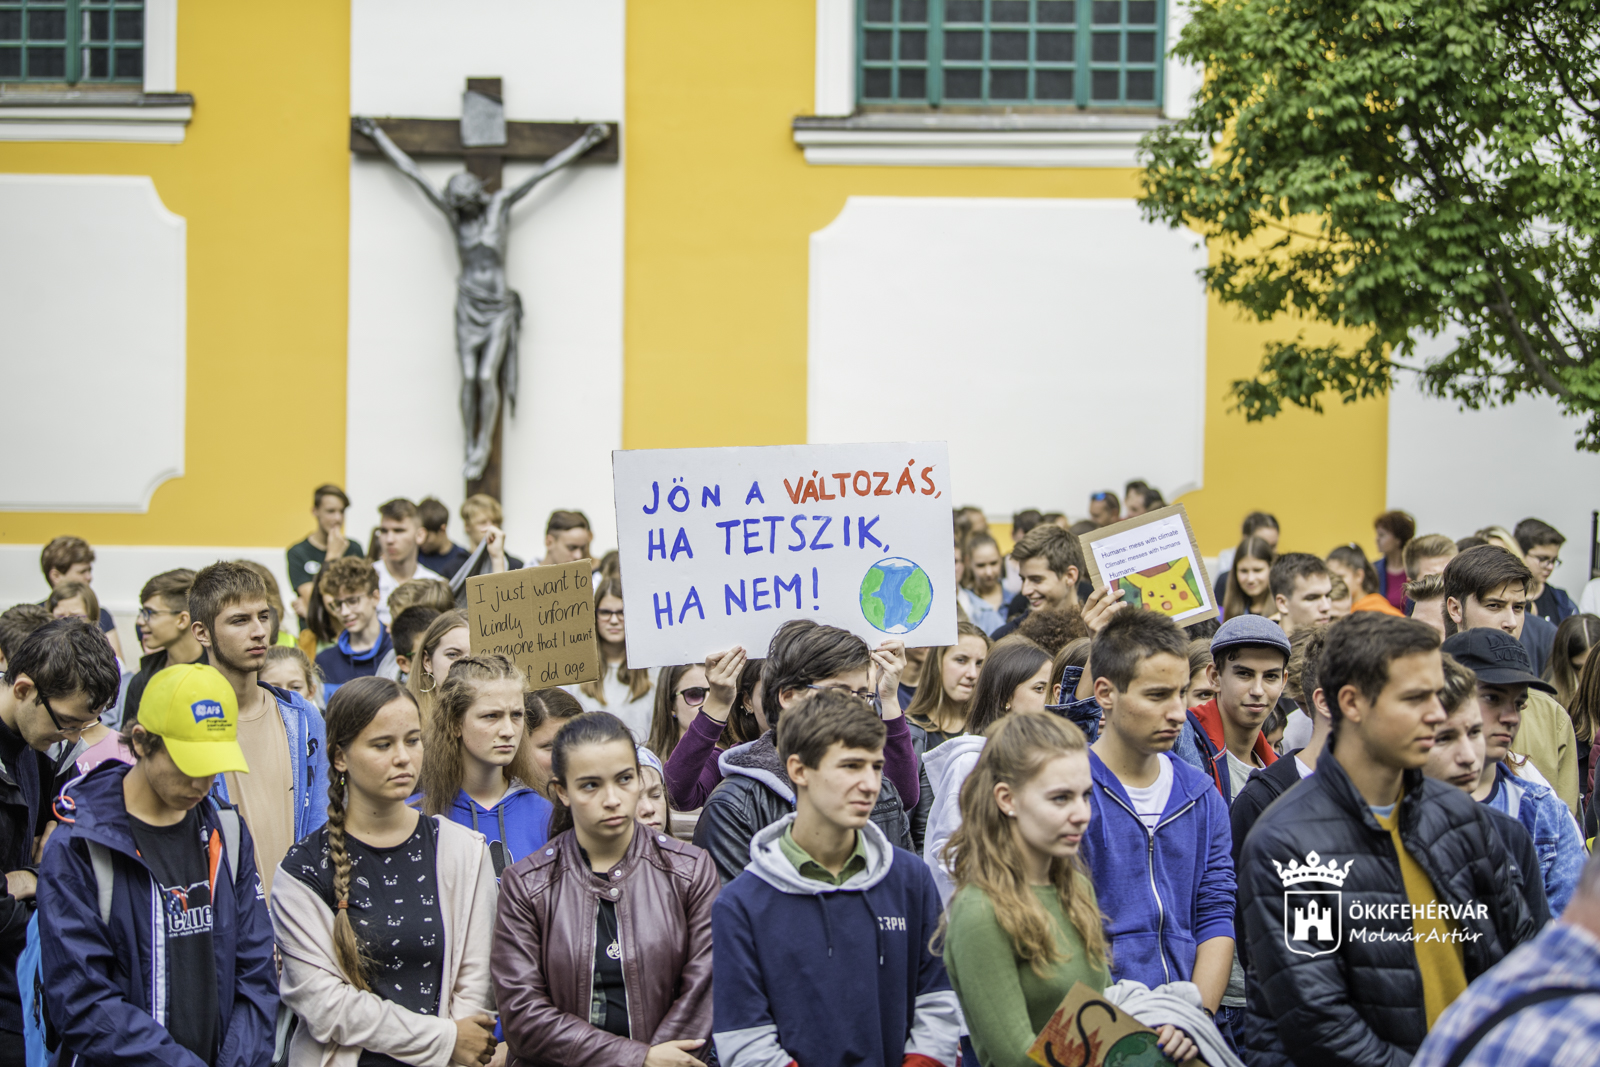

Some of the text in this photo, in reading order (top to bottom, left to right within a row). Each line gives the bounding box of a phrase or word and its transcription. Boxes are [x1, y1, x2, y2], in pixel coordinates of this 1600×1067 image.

[642, 458, 942, 515] JÖN A VÁLTOZÁS,
[647, 514, 890, 562] HA TETSZIK,
[1101, 529, 1179, 559] Humans: mess with climate
[1104, 540, 1181, 569] Climate: messes with humans
[1109, 566, 1137, 579] Humans:
[475, 569, 588, 613] I just want to
[653, 567, 819, 630] HA NEM!
[478, 600, 589, 639] kindly inform
[537, 632, 558, 651] that
[562, 630, 566, 646] I
[569, 628, 593, 644] want
[564, 662, 585, 681] age
